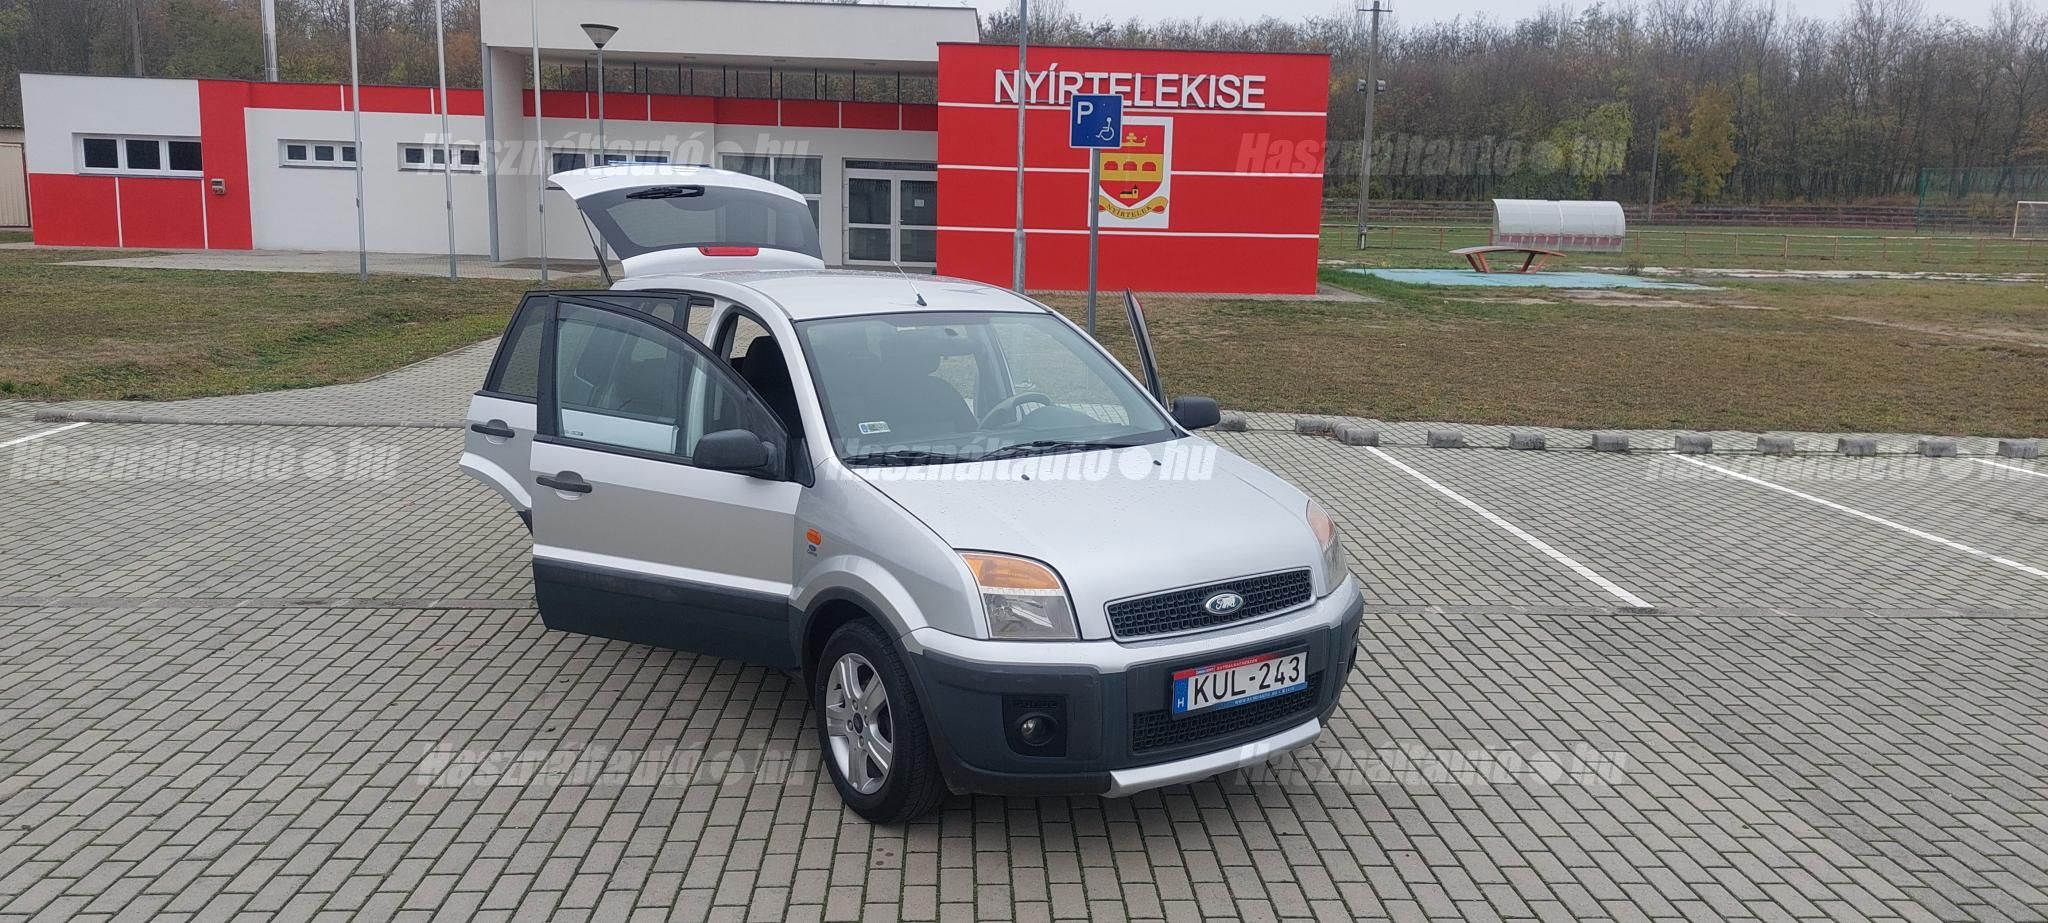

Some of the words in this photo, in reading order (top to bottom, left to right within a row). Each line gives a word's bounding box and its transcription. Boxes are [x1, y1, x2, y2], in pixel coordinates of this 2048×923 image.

[994, 62, 1267, 110] NYÍRTELEKISE
[1076, 101, 1094, 125] P
[1194, 656, 1300, 705] KUL-243
[1177, 696, 1185, 708] H
